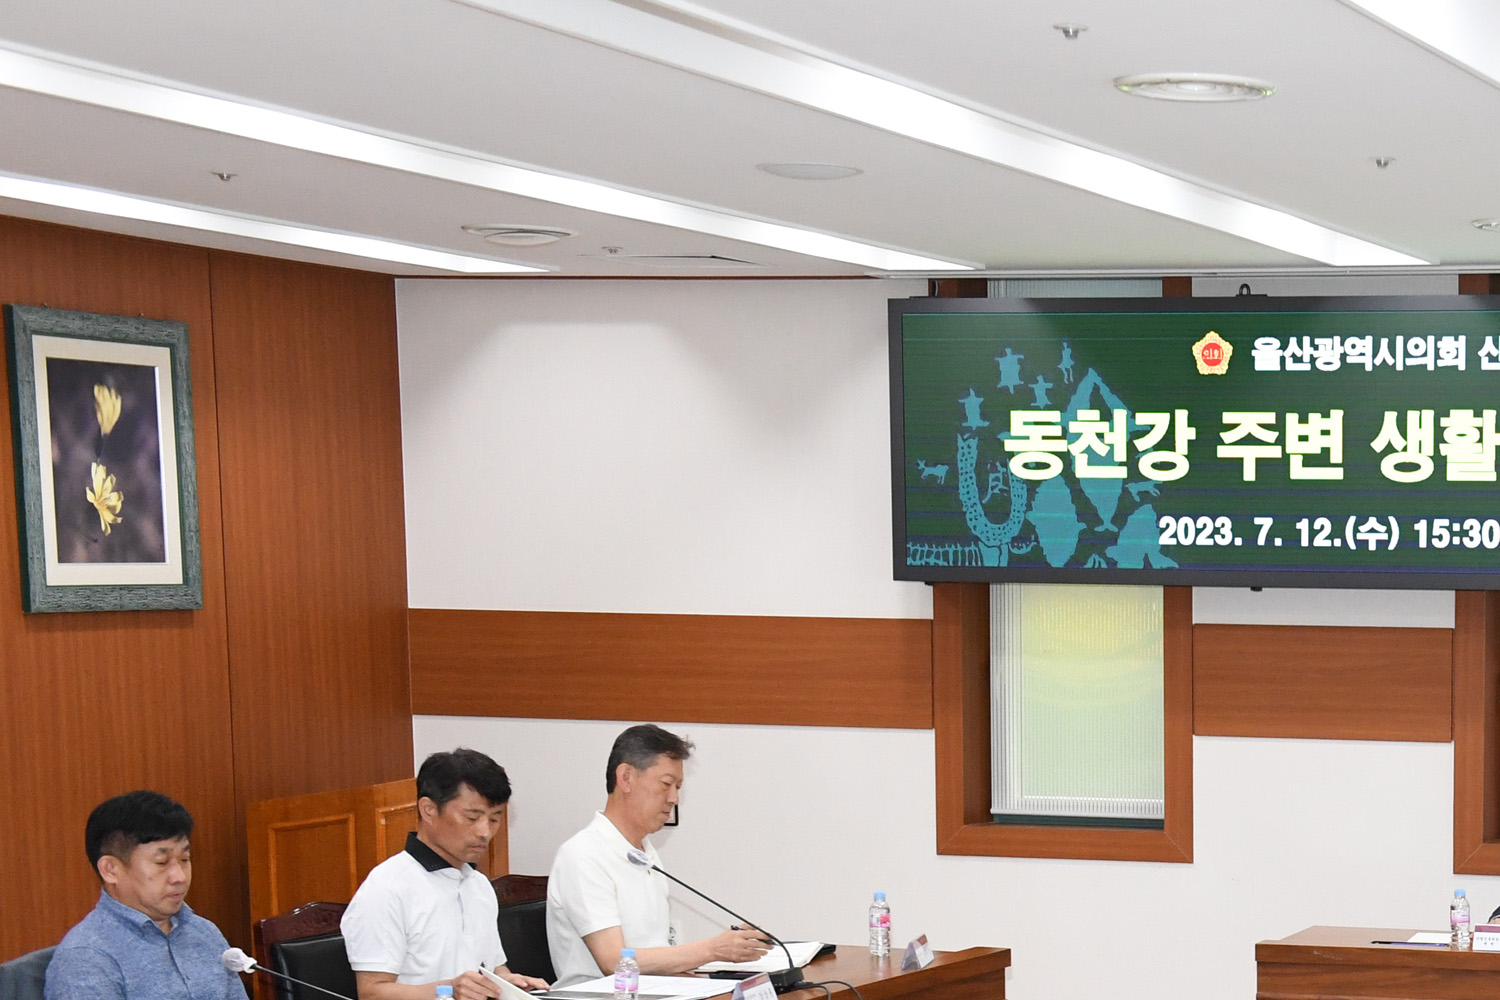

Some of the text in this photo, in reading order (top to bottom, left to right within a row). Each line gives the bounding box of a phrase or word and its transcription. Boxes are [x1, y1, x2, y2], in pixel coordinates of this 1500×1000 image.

[1252, 335, 1467, 371] 울산광역시의회
[1003, 409, 1196, 481] 동천강
[1216, 409, 1344, 481] 주변
[1159, 516, 1242, 546] 2023.
[1254, 518, 1283, 546] 7.
[1296, 516, 1400, 550] 12.(수)
[1413, 518, 1500, 548] 15:30
